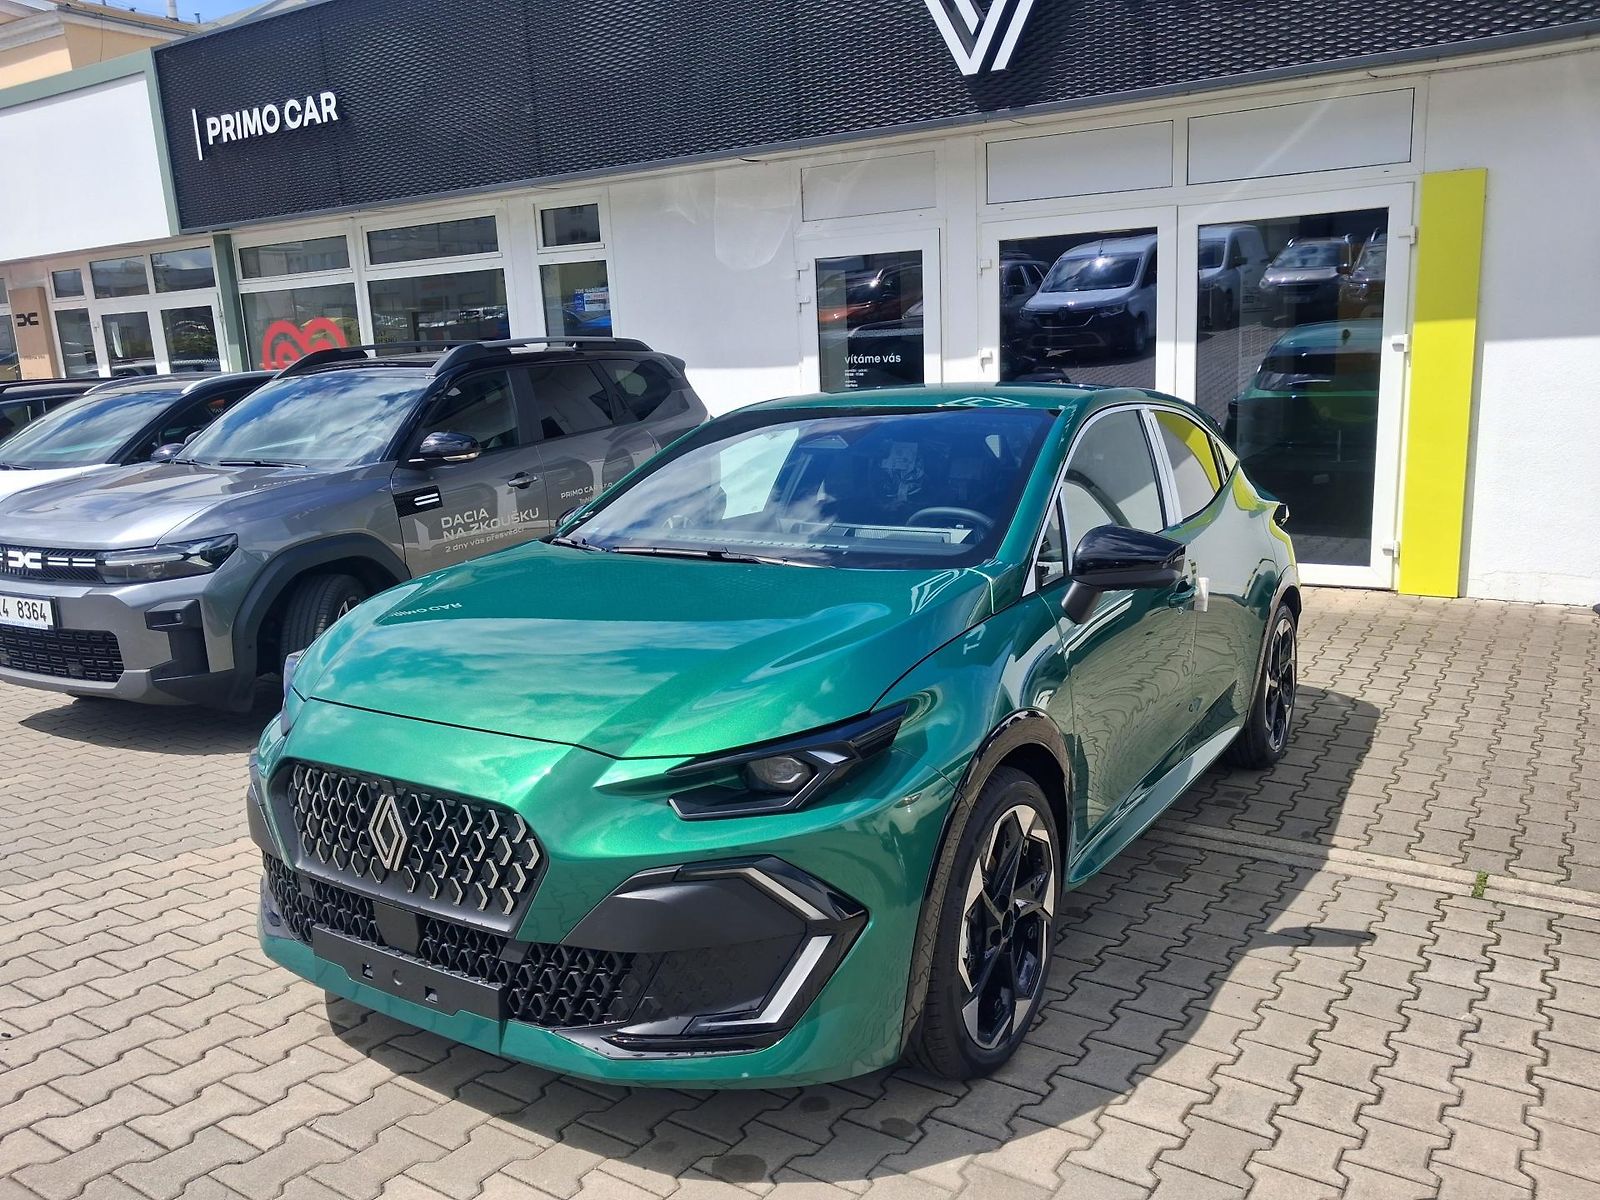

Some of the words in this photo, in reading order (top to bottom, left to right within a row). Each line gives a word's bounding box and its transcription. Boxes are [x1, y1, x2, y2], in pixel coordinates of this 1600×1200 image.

[206, 104, 280, 145] PRIMO
[284, 91, 339, 129] CAR
[845, 354, 881, 364] vítáme
[883, 353, 901, 363] vás
[560, 488, 584, 499] PRIMO
[441, 508, 489, 529] DACIA
[443, 527, 465, 540] NA
[469, 507, 539, 534] ZKOUŠKU
[445, 545, 451, 553] 2
[452, 541, 469, 551] dny
[17, 600, 47, 622] 8364
